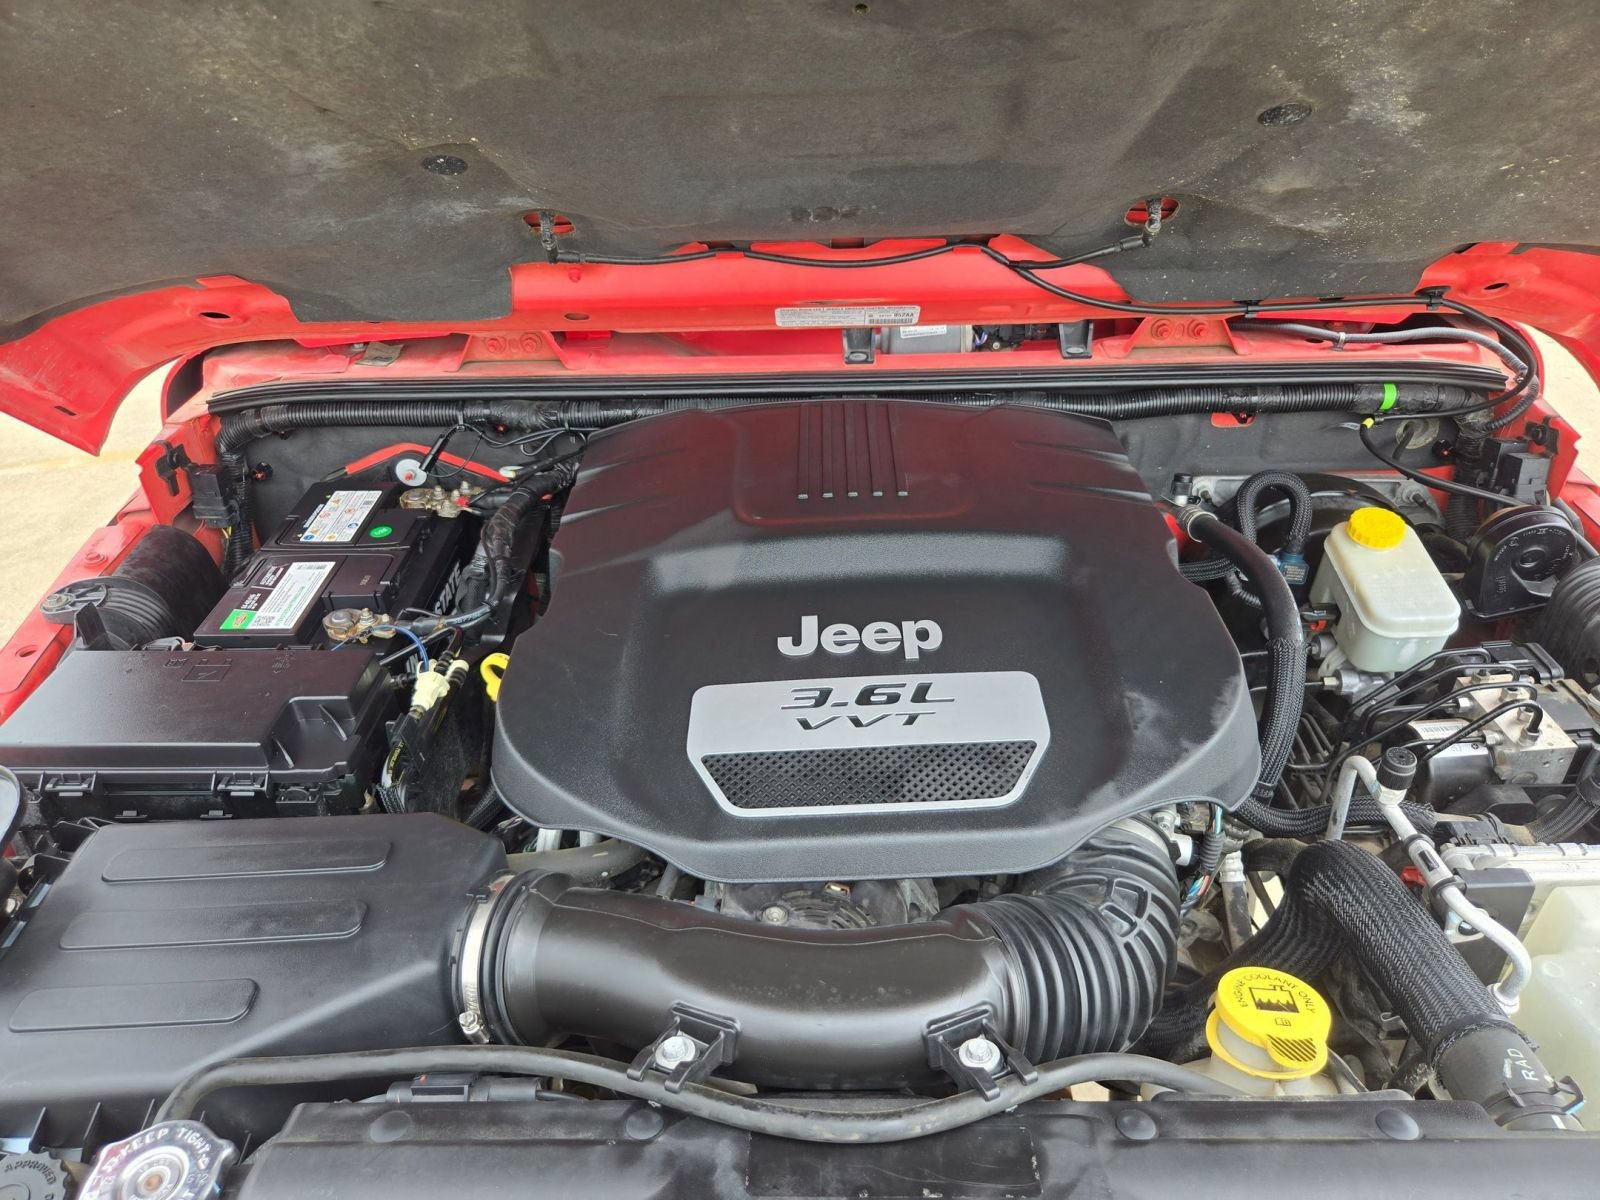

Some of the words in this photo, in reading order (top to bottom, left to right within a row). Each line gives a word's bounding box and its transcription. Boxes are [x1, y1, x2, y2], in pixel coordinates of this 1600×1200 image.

[434, 561, 461, 615] STATE
[777, 615, 943, 660] Jeep
[781, 682, 955, 710] 3.6L
[796, 711, 936, 731] VVT
[1233, 980, 1249, 1008] ENGINE
[1243, 973, 1297, 990] COOLANT
[1298, 990, 1317, 1014] ONLY
[1507, 1048, 1539, 1081] RAD
[120, 1127, 169, 1158] KEEP
[176, 1127, 212, 1155] TIGHT
